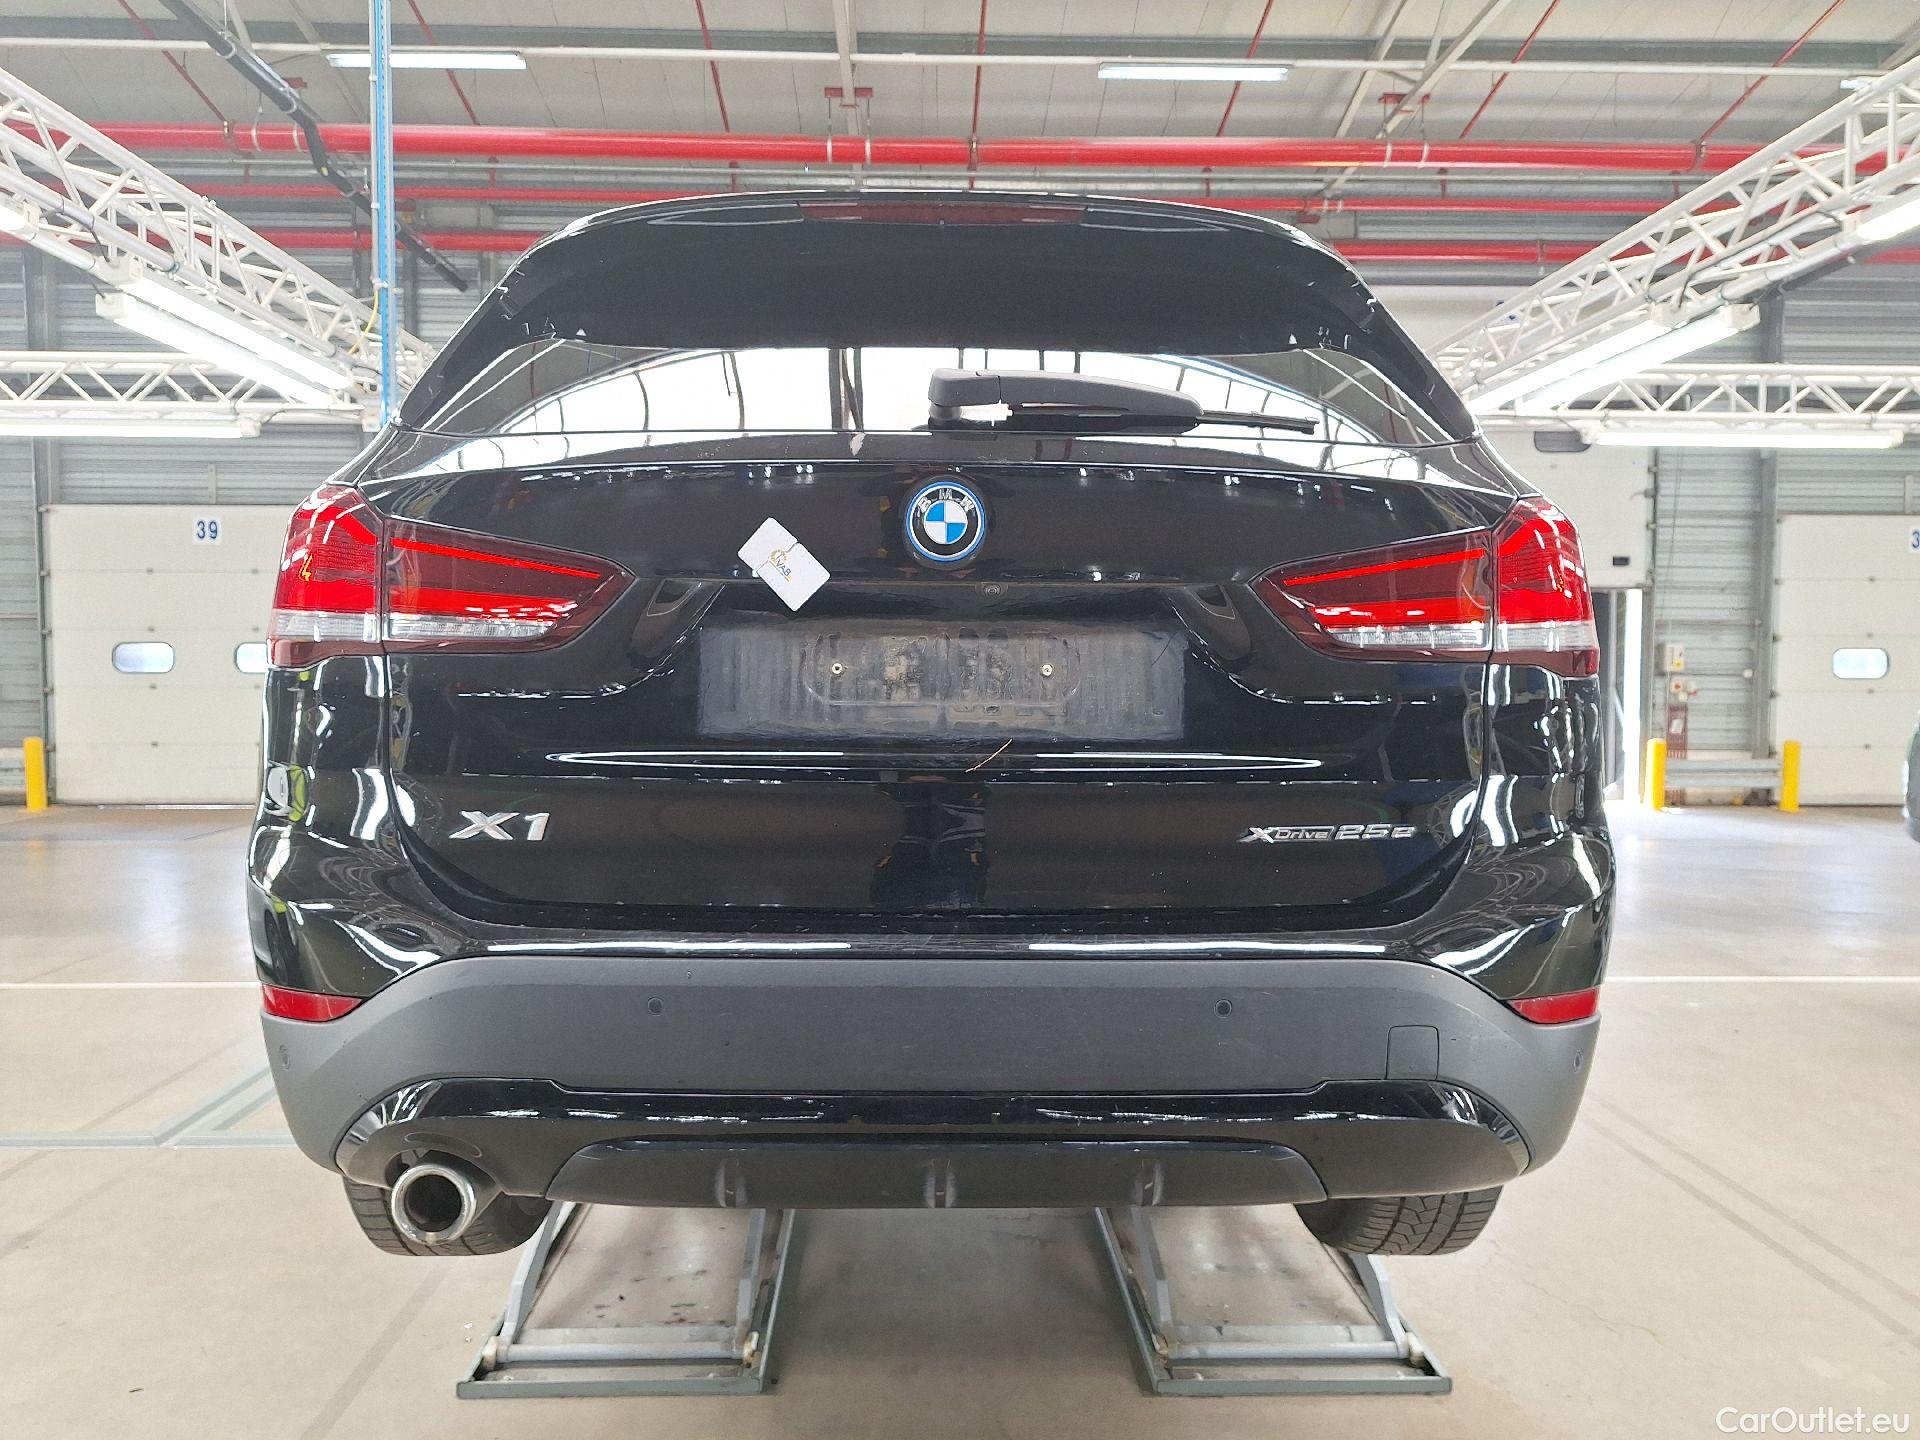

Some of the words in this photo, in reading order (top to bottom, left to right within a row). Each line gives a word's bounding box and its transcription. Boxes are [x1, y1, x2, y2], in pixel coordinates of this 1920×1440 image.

[918, 487, 975, 513] BMW
[197, 520, 218, 539] 39
[448, 810, 551, 841] X1
